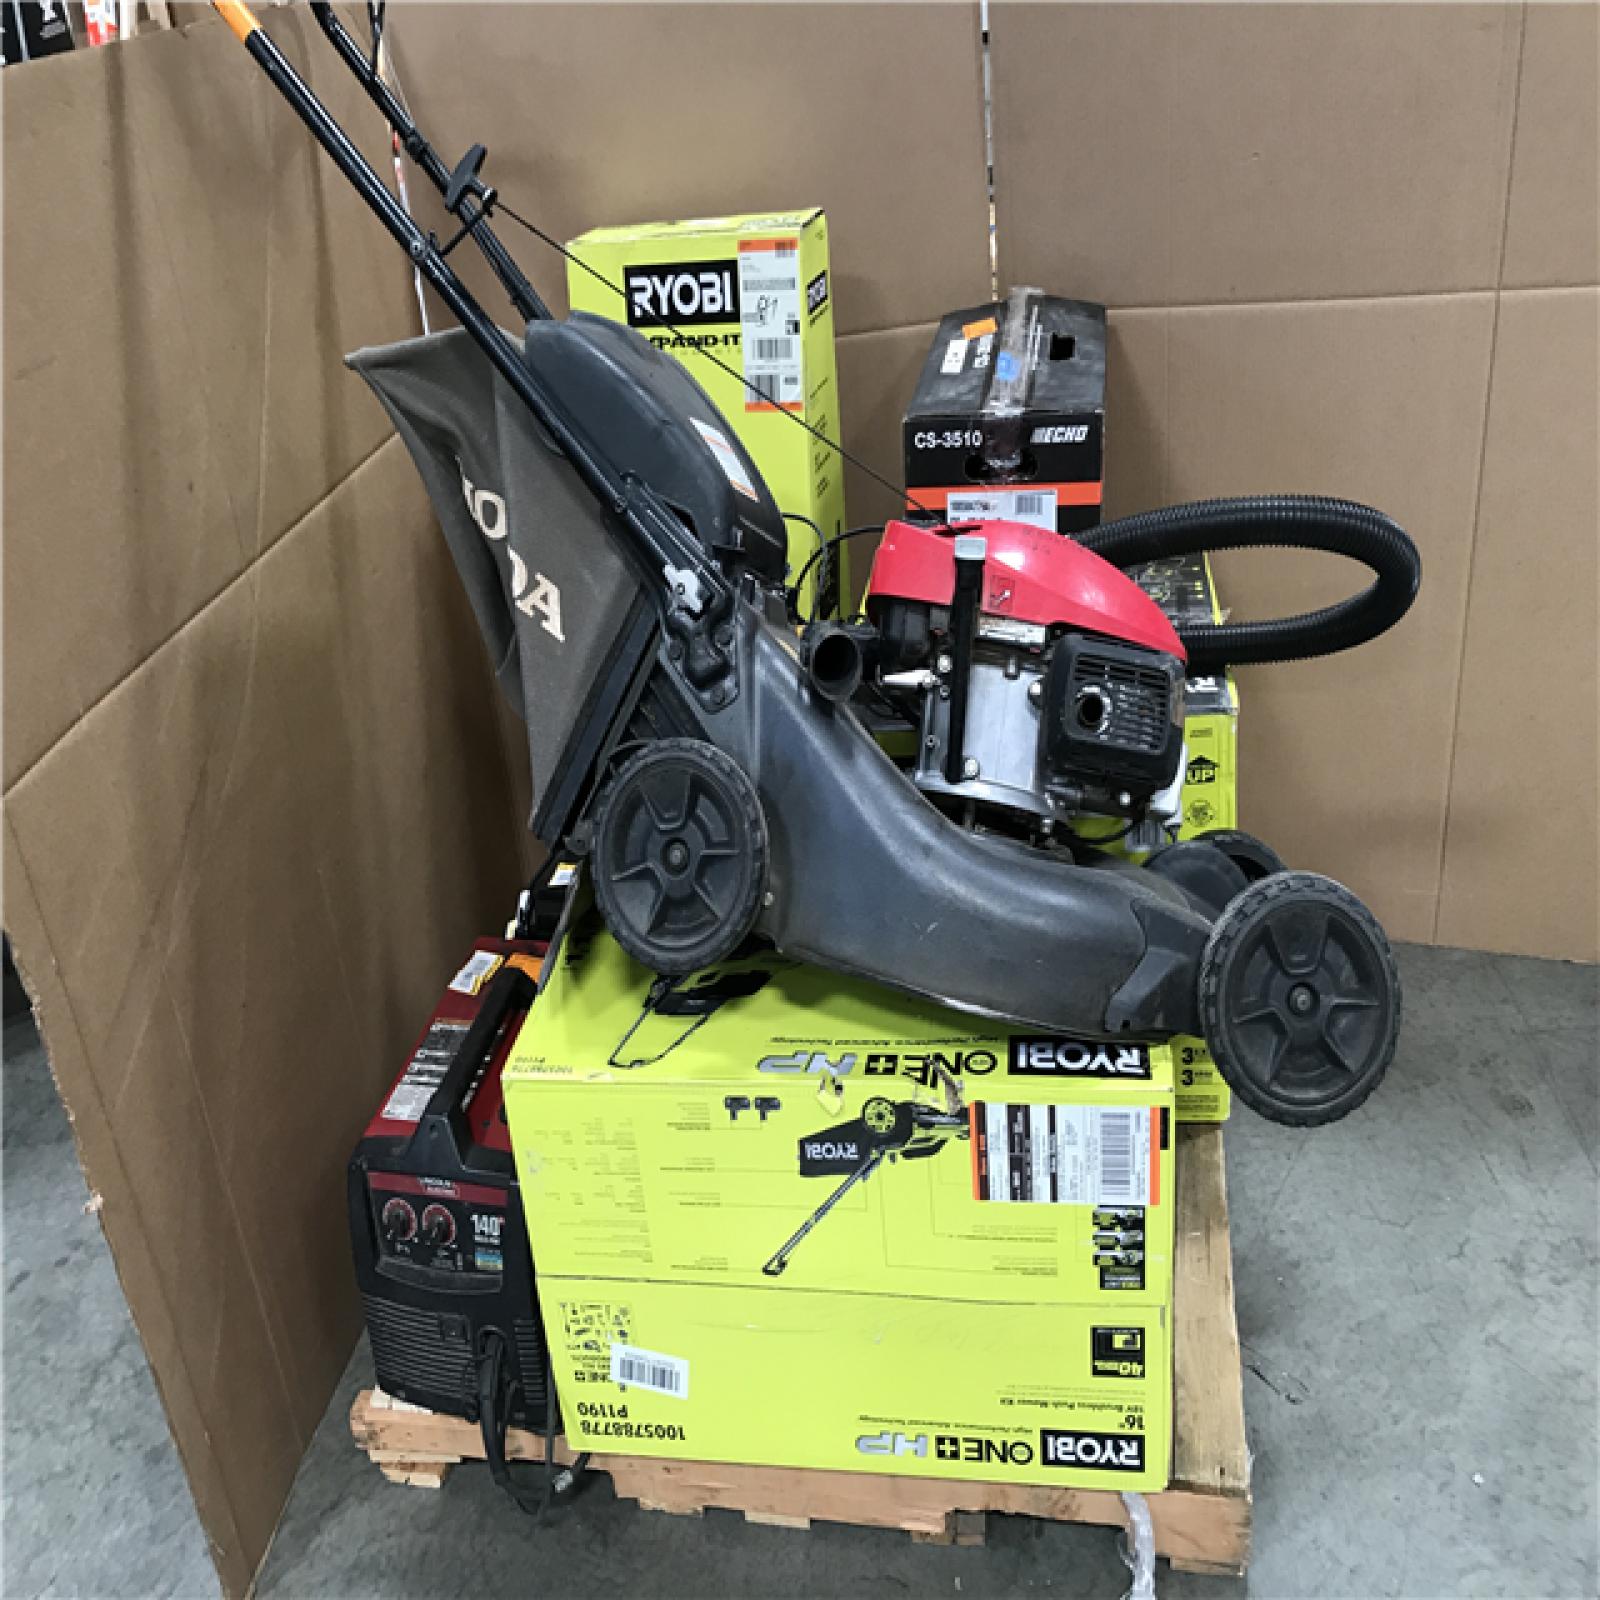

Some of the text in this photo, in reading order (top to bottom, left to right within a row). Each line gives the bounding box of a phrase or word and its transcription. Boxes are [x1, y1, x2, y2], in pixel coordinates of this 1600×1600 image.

[629, 270, 735, 318] RYOBI
[914, 430, 983, 448] CS-3510
[756, 1051, 858, 1076] HP
[1017, 1042, 1142, 1074] RYOBI
[804, 1142, 859, 1160] RYOBI
[577, 1402, 628, 1418] P1190
[580, 1420, 686, 1440] 1005788778
[855, 1431, 929, 1458] HP
[1046, 1435, 1140, 1466] RYOBI
